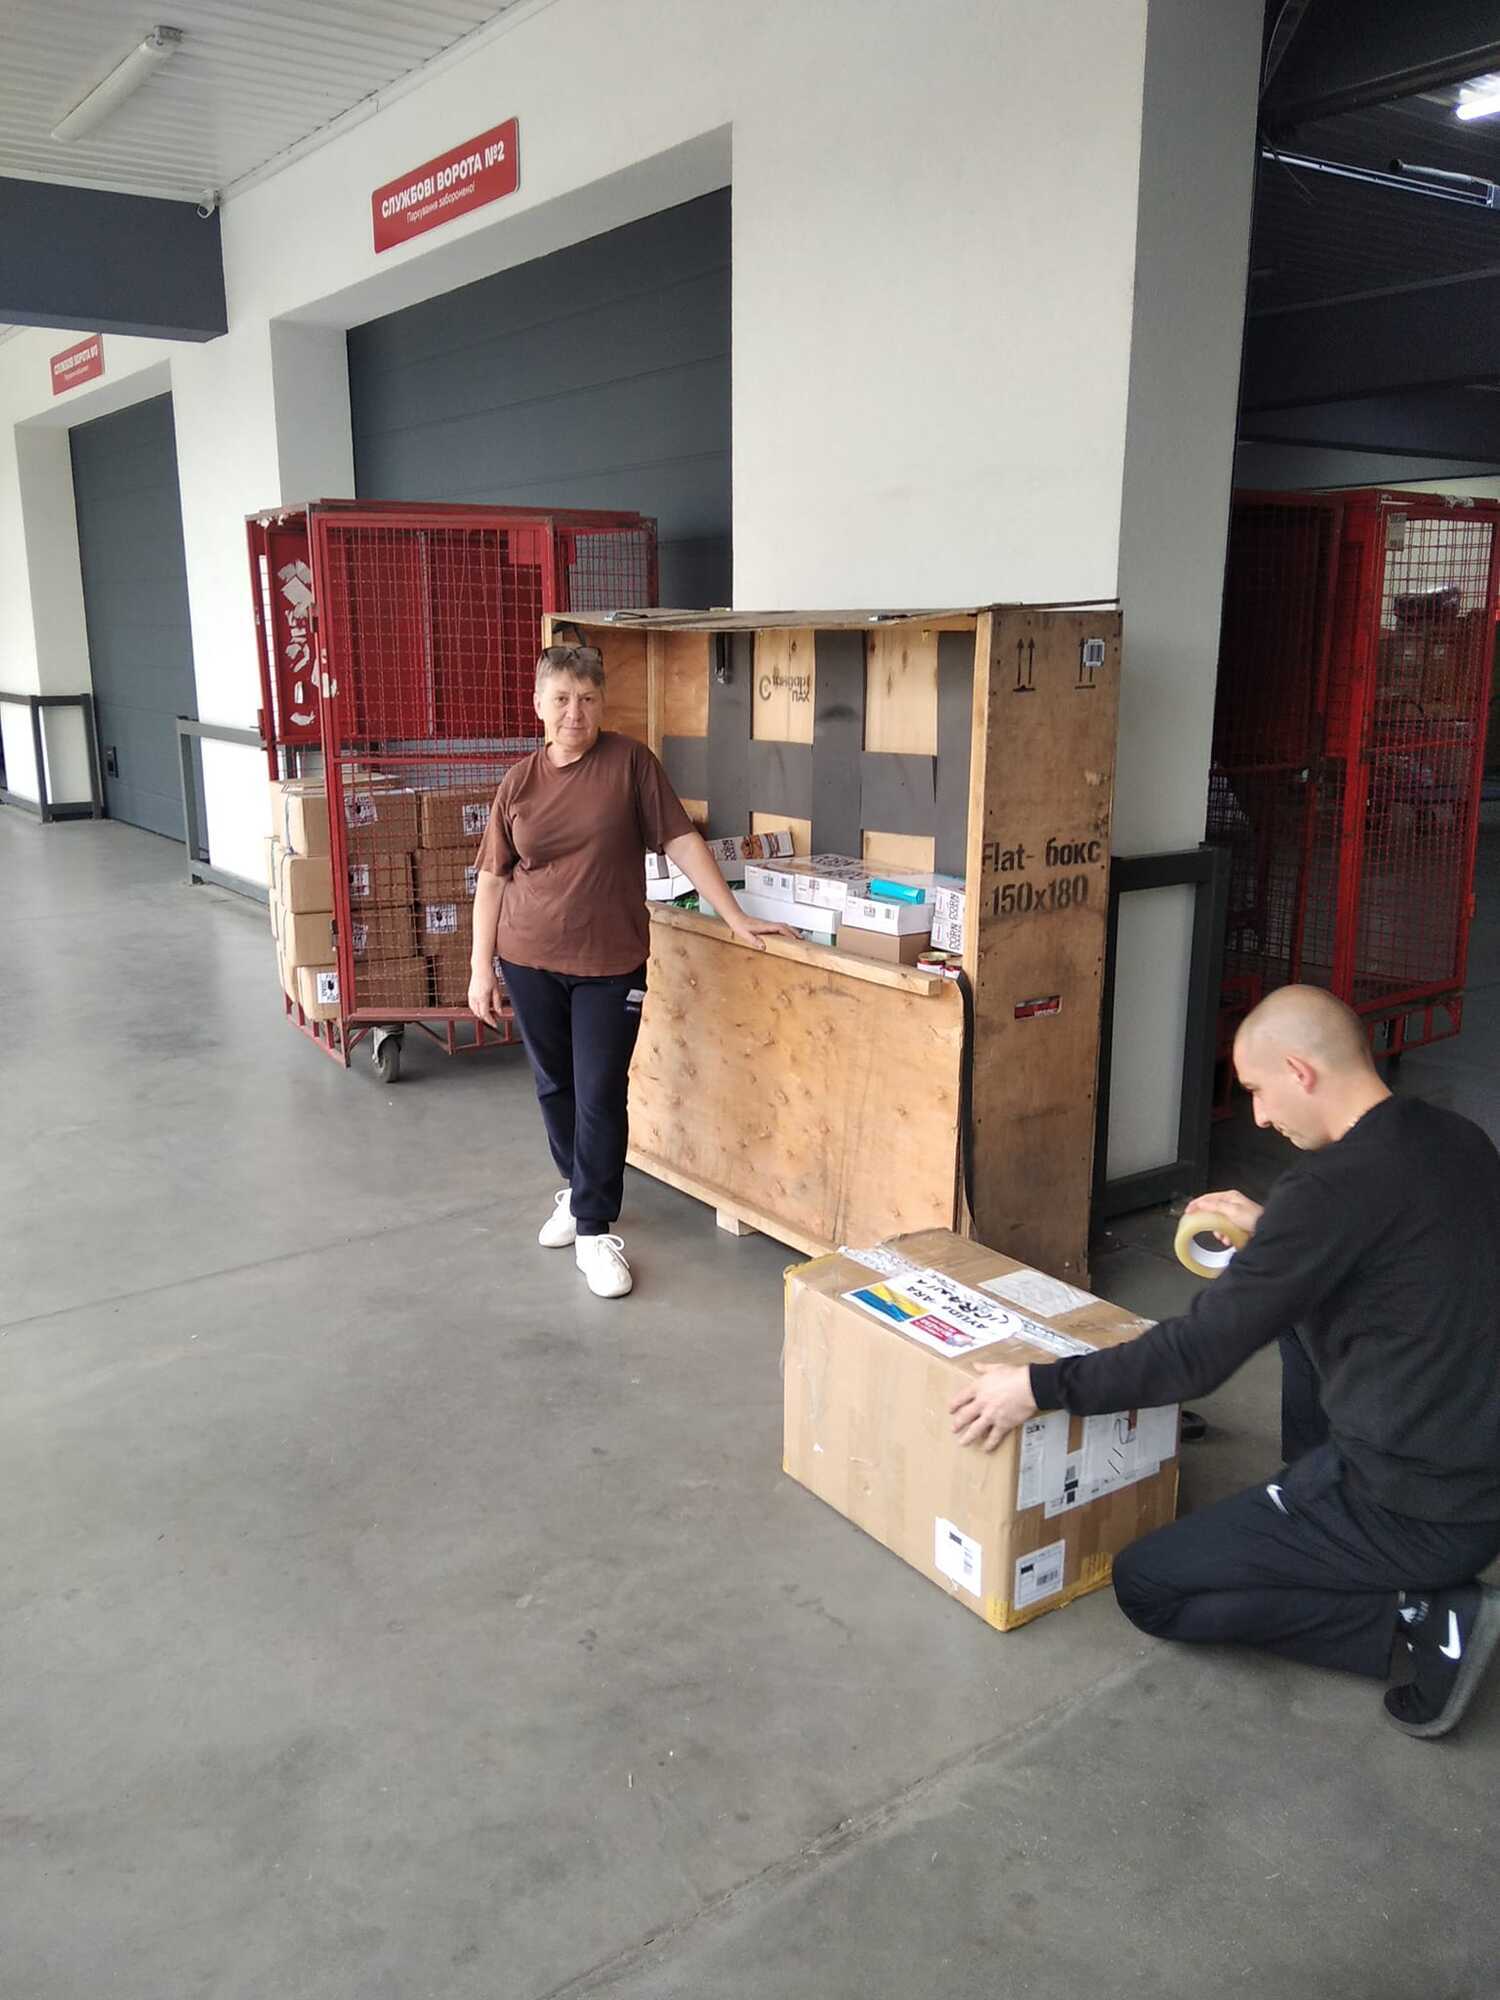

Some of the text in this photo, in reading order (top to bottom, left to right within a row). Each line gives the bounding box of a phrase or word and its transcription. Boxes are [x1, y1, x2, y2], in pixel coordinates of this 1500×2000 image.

[381, 140, 505, 219] СЛУЖБОВІ ВОРОТА №2
[1045, 837, 1102, 867] бокс
